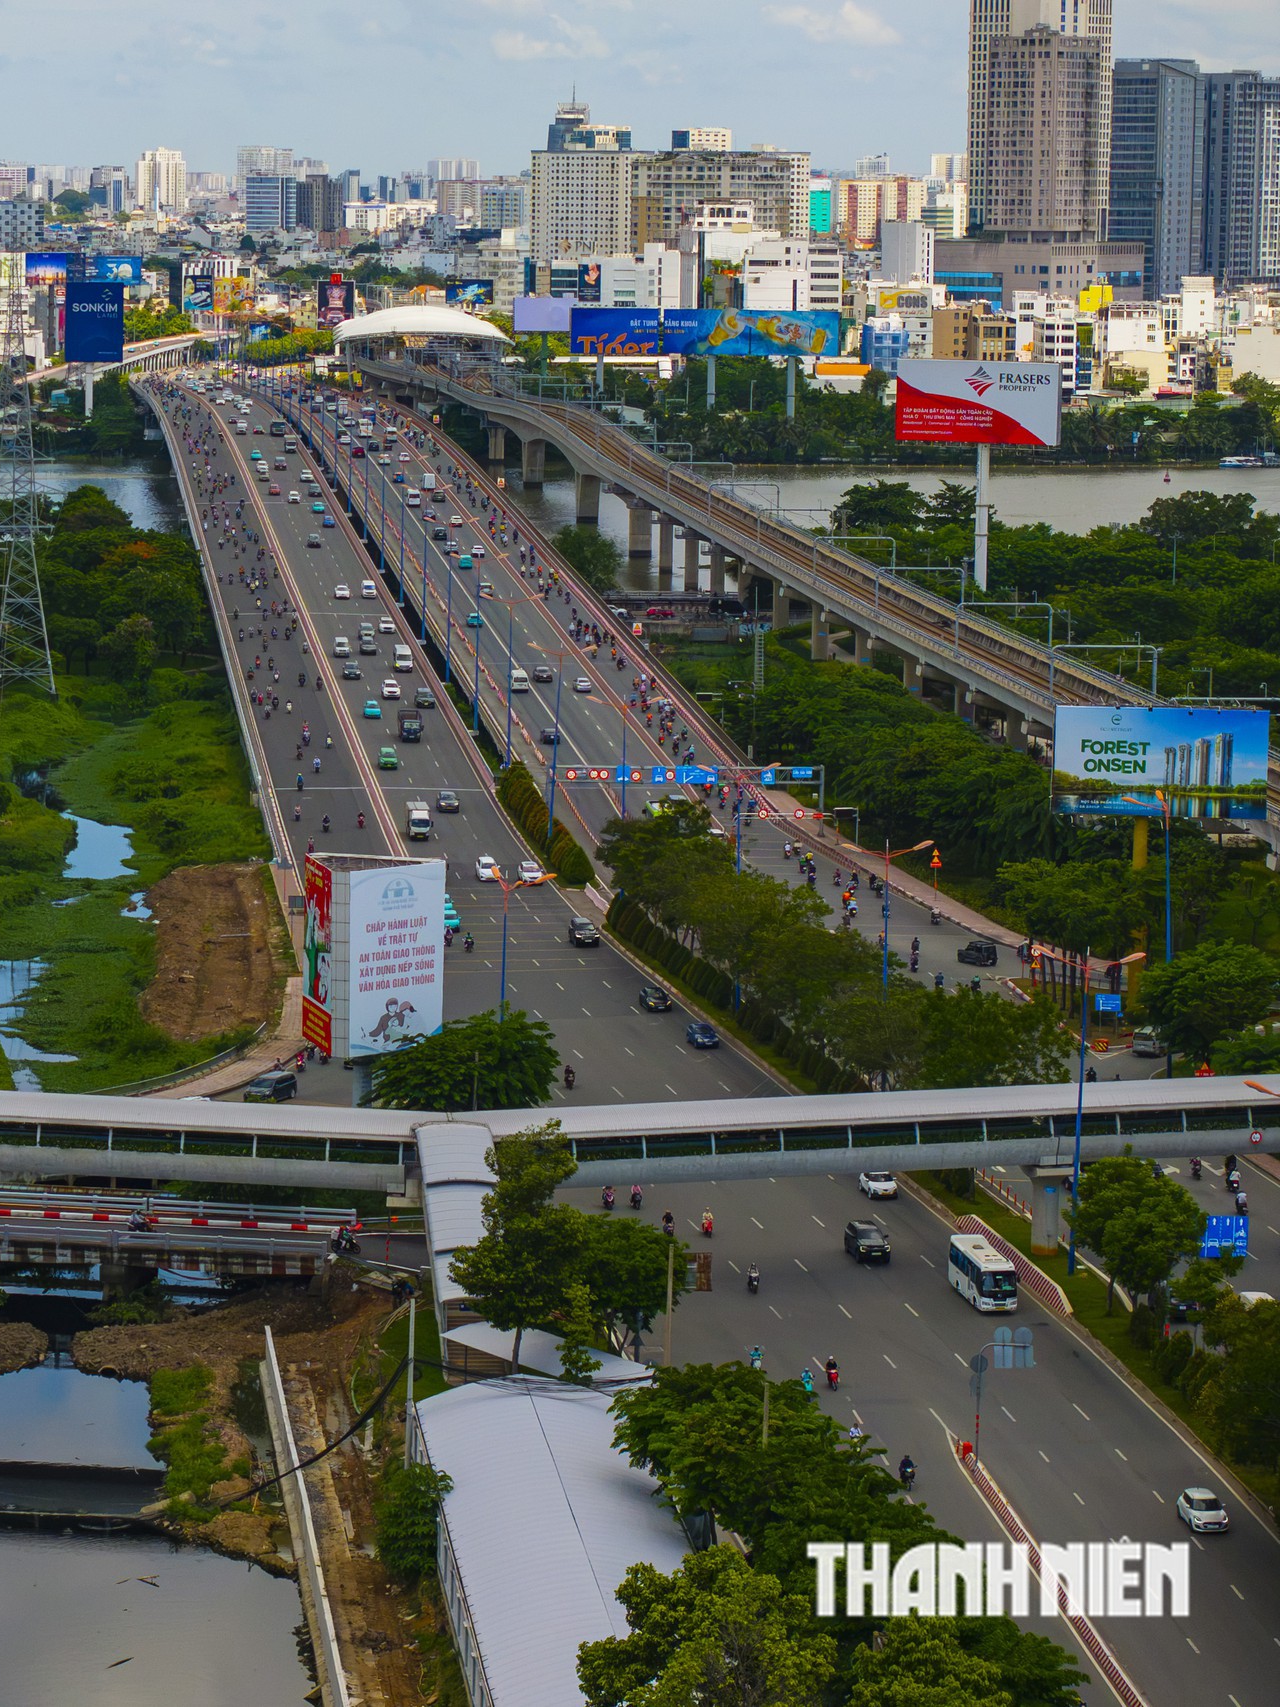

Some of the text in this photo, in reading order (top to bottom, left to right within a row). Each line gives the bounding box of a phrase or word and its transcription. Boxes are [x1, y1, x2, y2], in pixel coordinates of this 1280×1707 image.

[575, 240, 595, 254] PNJ
[72, 302, 118, 313] SONKIM
[999, 372, 1051, 386] FRASERS
[1081, 739, 1150, 757] FOREST
[1083, 758, 1147, 775] ONSEN
[365, 916, 428, 933] CHẤP HÀNH LUẬT
[389, 933, 408, 947] TRẬT
[408, 931, 419, 944] TỰ
[359, 944, 436, 964] AN TOÀN GIAO THÔNG
[359, 964, 375, 979] XÂY
[376, 963, 396, 978] DỰNG
[398, 959, 413, 975] NẾP
[358, 979, 374, 993] VĂN
[392, 976, 410, 988] GIAO
[411, 972, 435, 986] THÔNG
